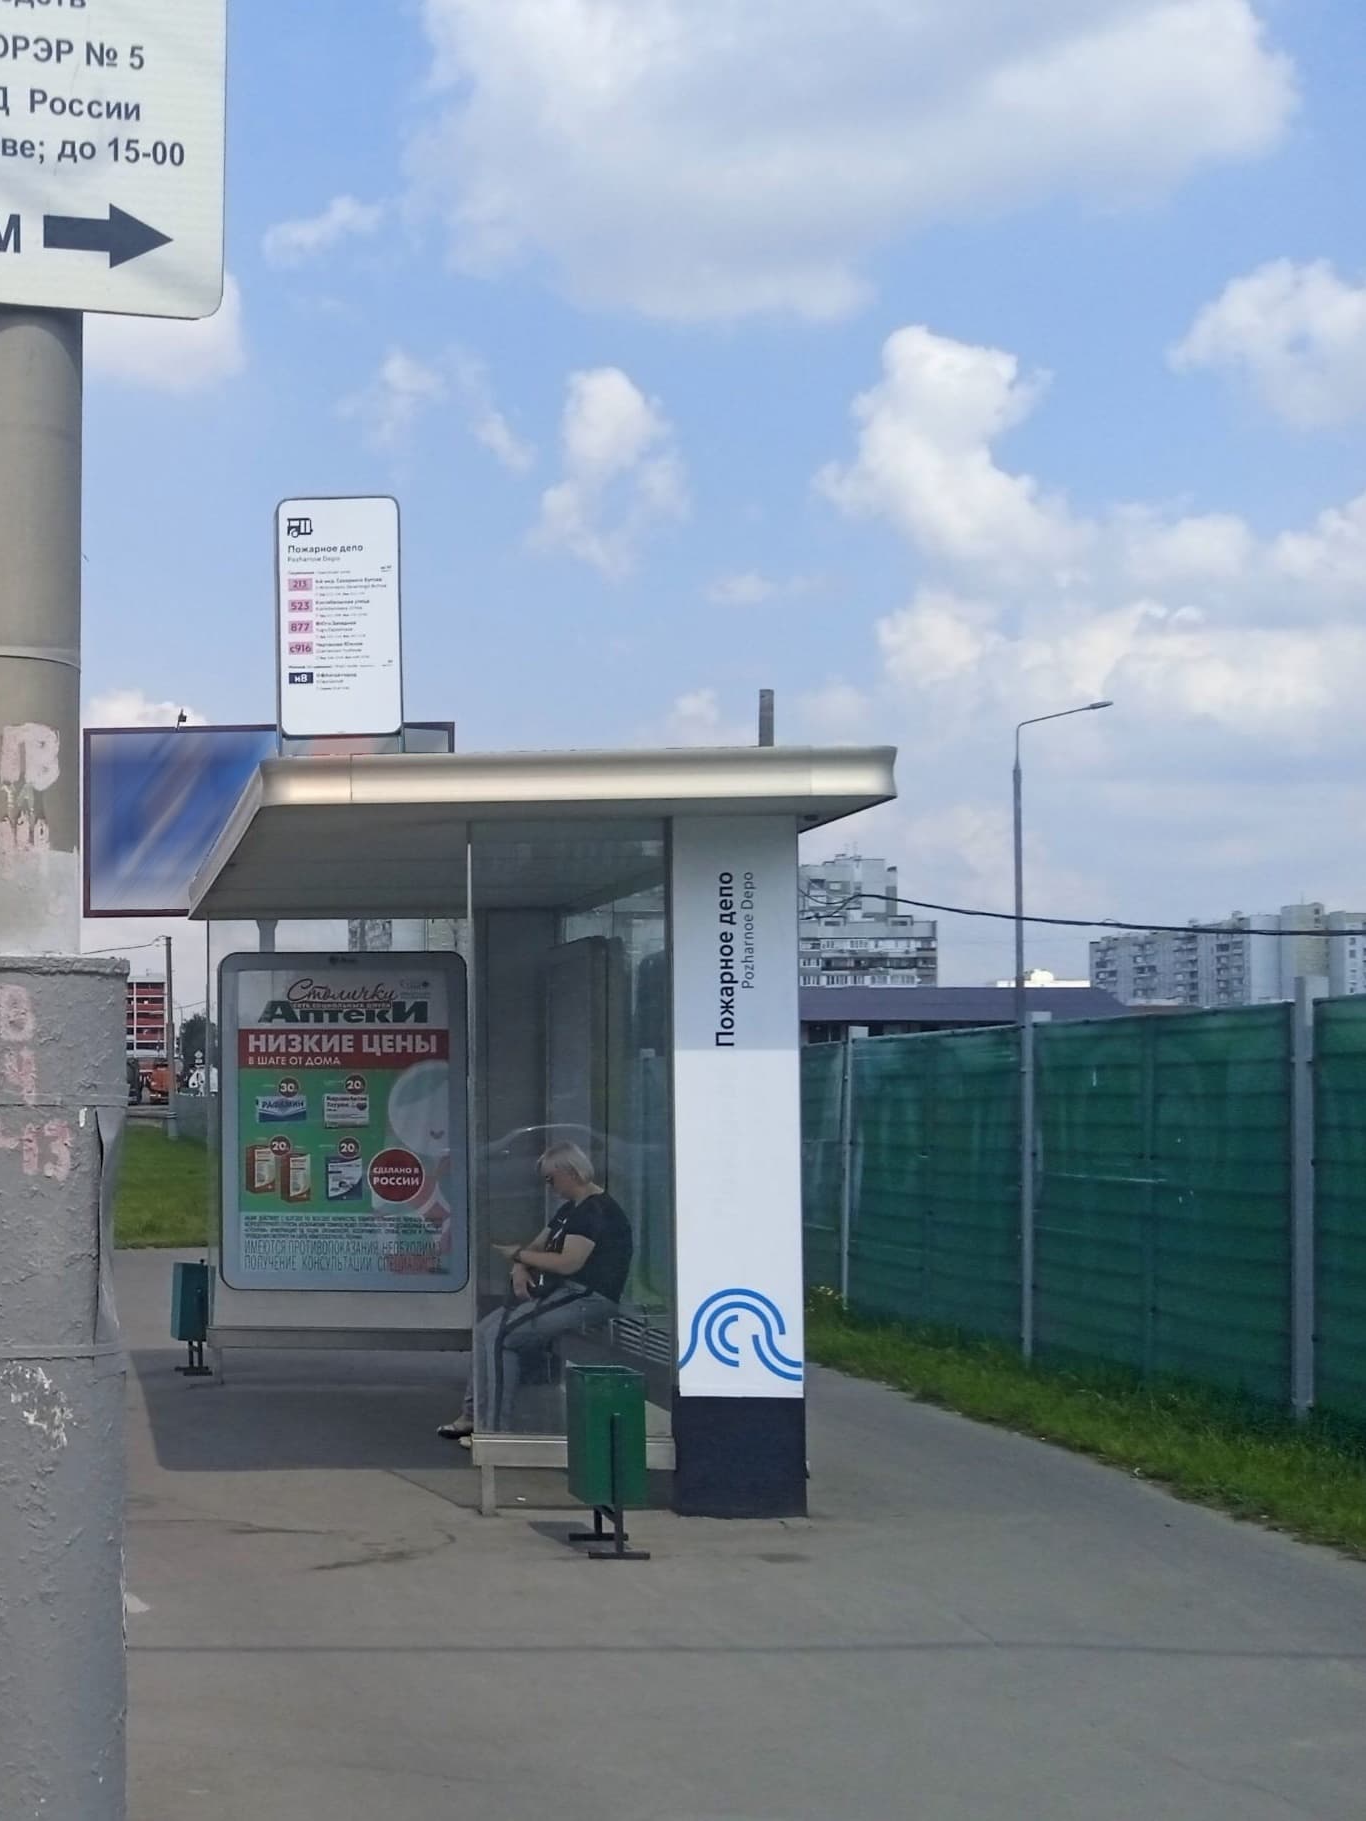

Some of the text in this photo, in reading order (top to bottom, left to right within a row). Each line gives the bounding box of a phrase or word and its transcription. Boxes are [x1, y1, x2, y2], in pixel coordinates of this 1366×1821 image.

[85, 41, 118, 67] №
[129, 46, 145, 70] 5
[29, 89, 141, 121] России
[57, 139, 96, 162] до
[107, 138, 185, 166] 15-00
[287, 544, 364, 555] Пожарное депо
[293, 580, 307, 588] 213
[290, 601, 310, 611] 523
[290, 623, 310, 632] 877
[741, 871, 758, 989] Pozharnoe Depo
[715, 871, 738, 1047] Пожарное депо
[287, 977, 398, 1001] Столички
[248, 1034, 437, 1056] НИЗКИЕ ЦЕНЫ
[248, 1056, 341, 1066] В ШАГЕ ОТ ДОМА
[373, 1177, 420, 1186] РОССИИ
[244, 1239, 286, 1255] ИМЕЮТСЯ
[244, 1256, 297, 1271] ПОЛУЧЕНИЕ
